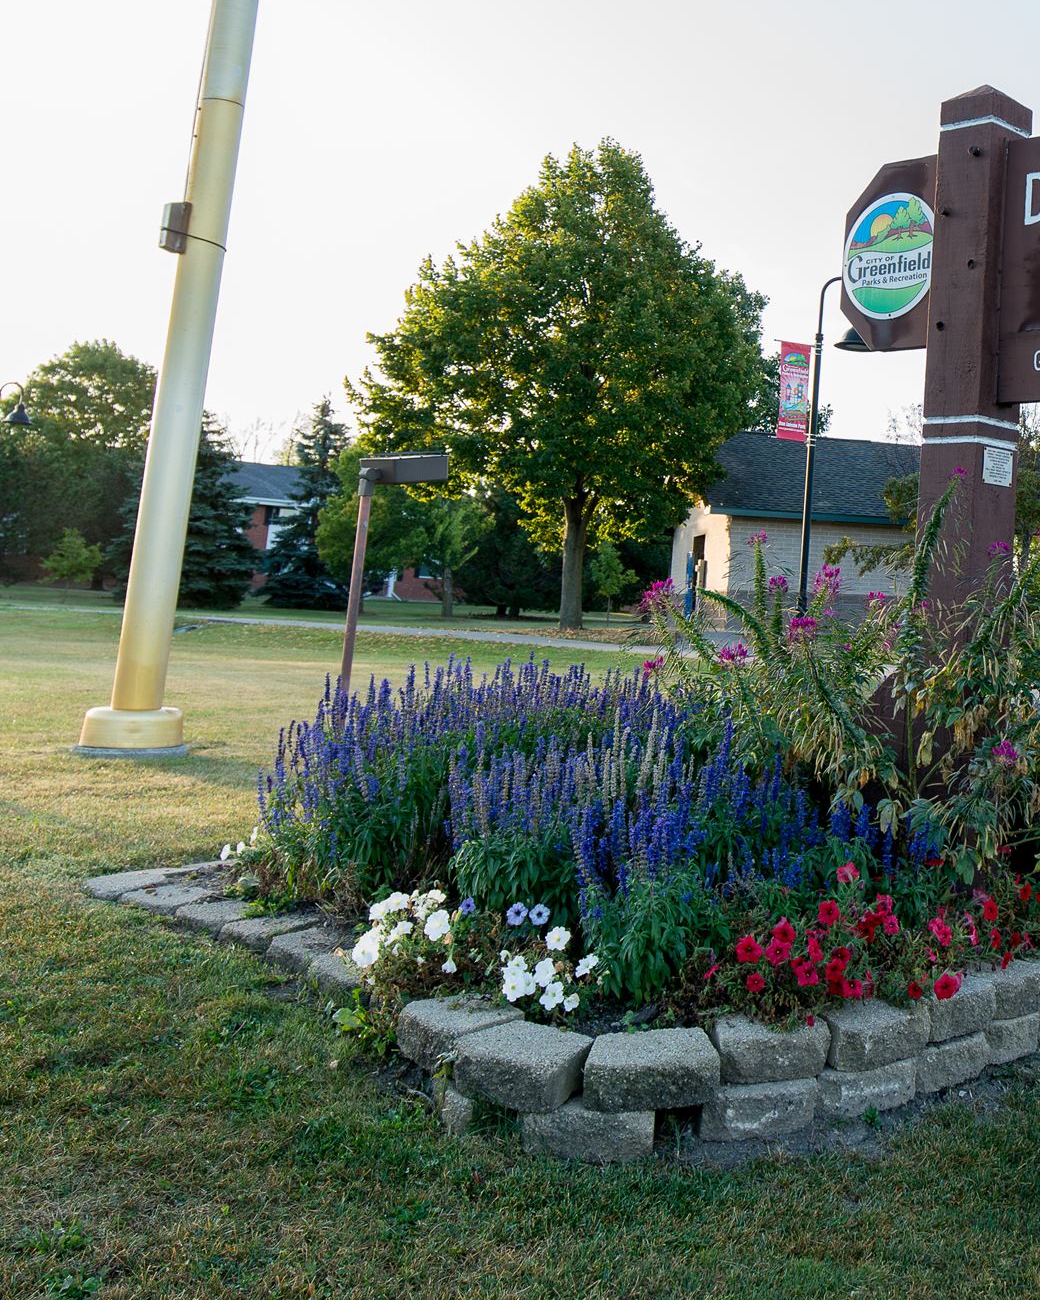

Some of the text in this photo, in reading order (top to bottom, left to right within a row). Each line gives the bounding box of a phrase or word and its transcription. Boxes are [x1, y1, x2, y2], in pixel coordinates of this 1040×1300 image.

[847, 251, 931, 284] Greenfield
[866, 257, 883, 265] CITY
[862, 272, 928, 286] Parks & Recreation
